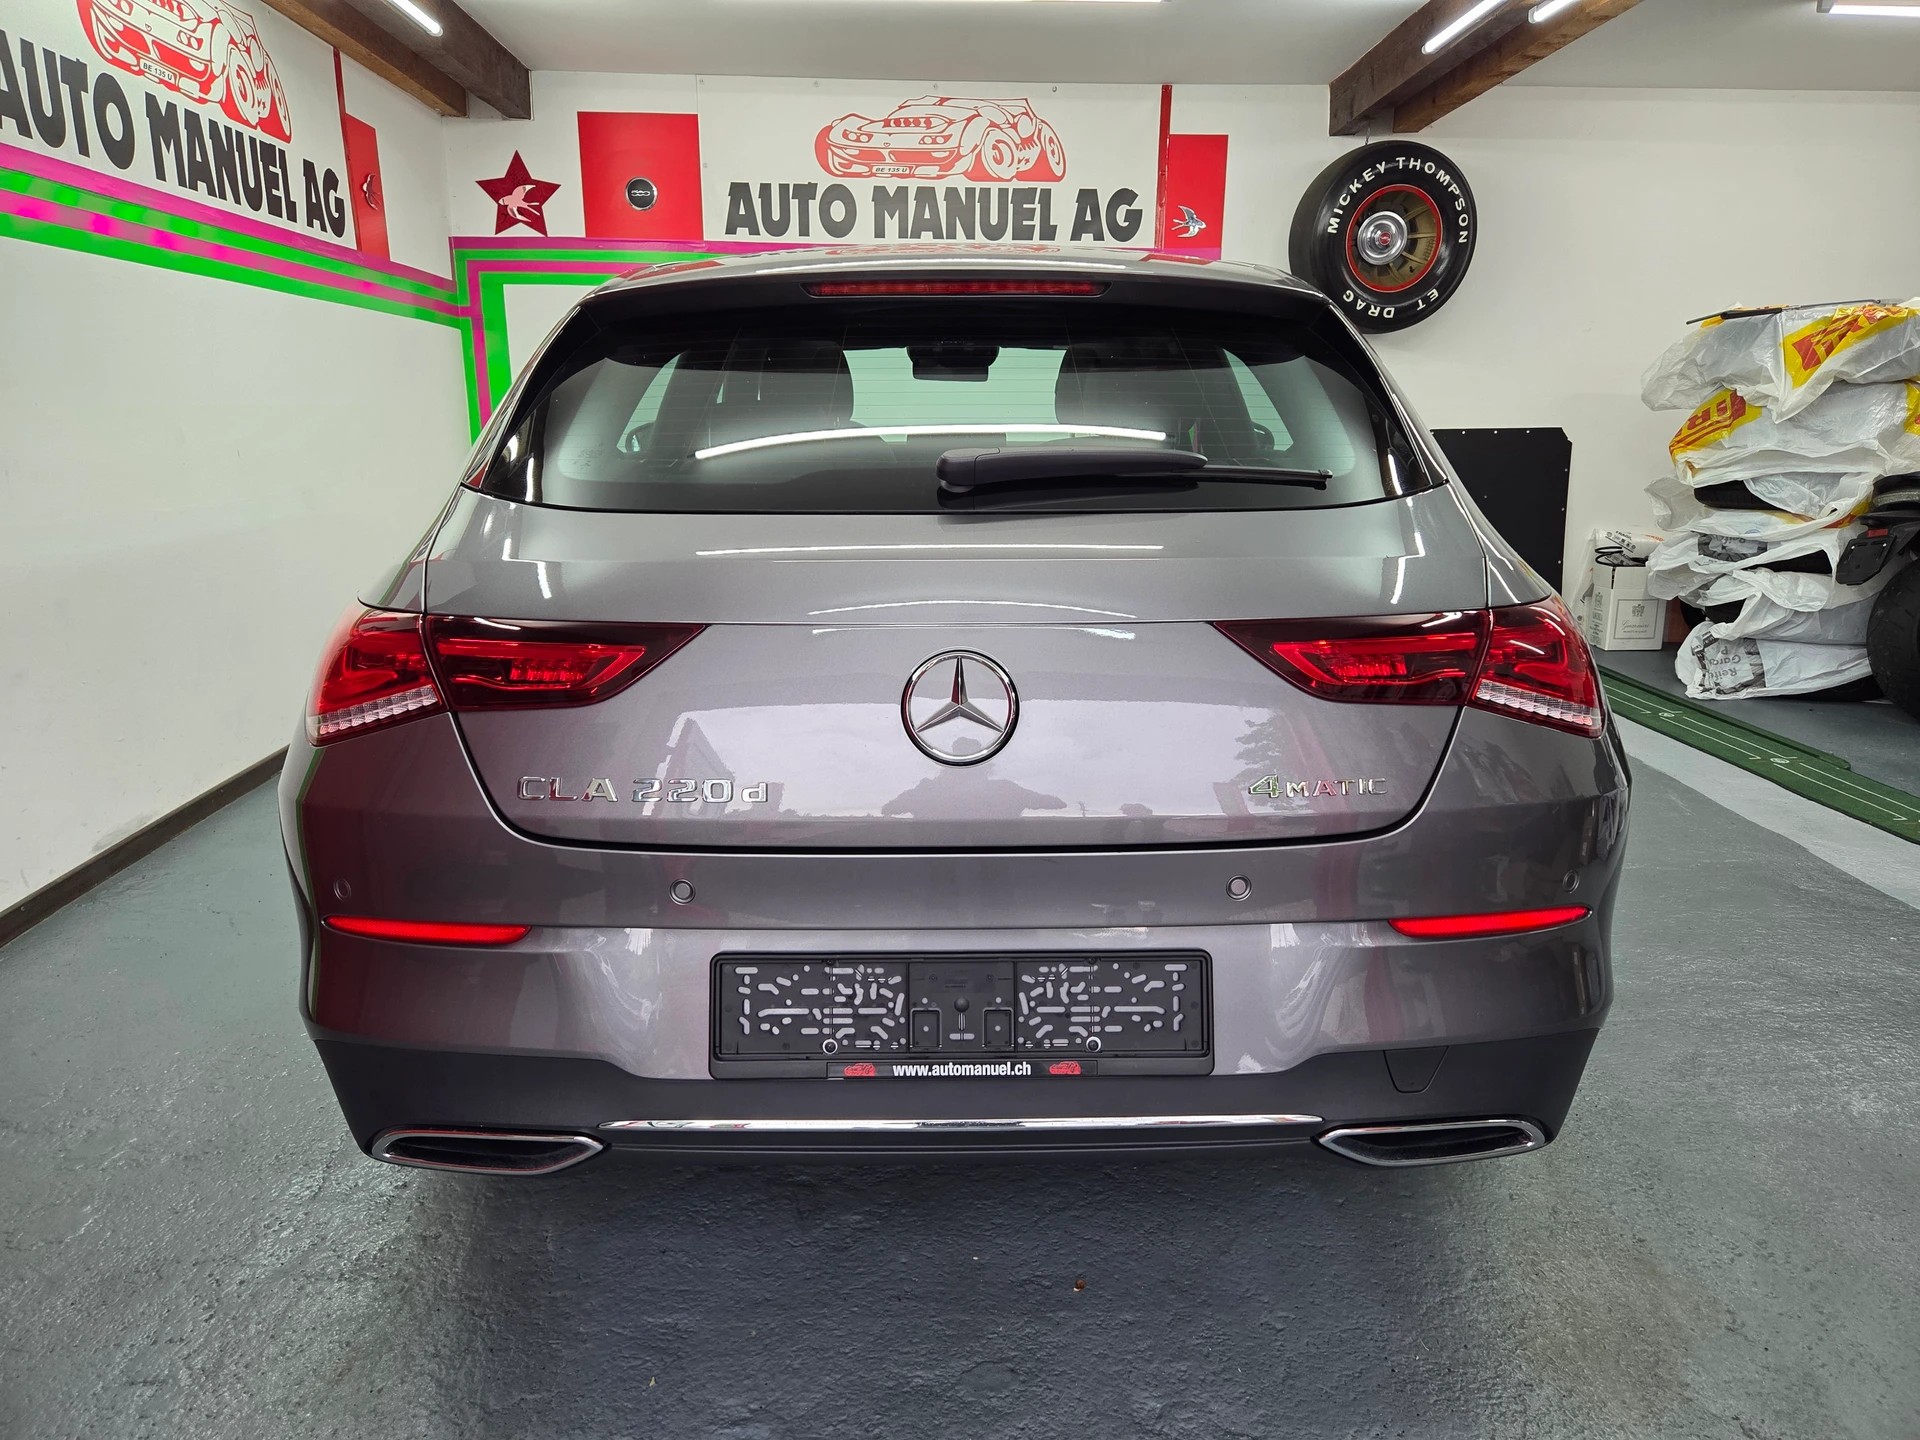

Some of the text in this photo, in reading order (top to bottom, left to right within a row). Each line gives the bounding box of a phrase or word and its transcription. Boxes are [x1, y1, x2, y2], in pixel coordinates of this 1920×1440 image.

[142, 62, 173, 81] BE 135 U
[0, 29, 346, 238] AUTO MANUEL AG
[725, 181, 1143, 242] AUTO MANUEL AG
[1327, 157, 1469, 244] MICKEY THOMPSON
[1343, 288, 1439, 319] ET DRAG
[517, 776, 618, 802] CLA
[1248, 773, 1388, 798] 4MATIC
[892, 1061, 1032, 1077] www.automanuel.ch
